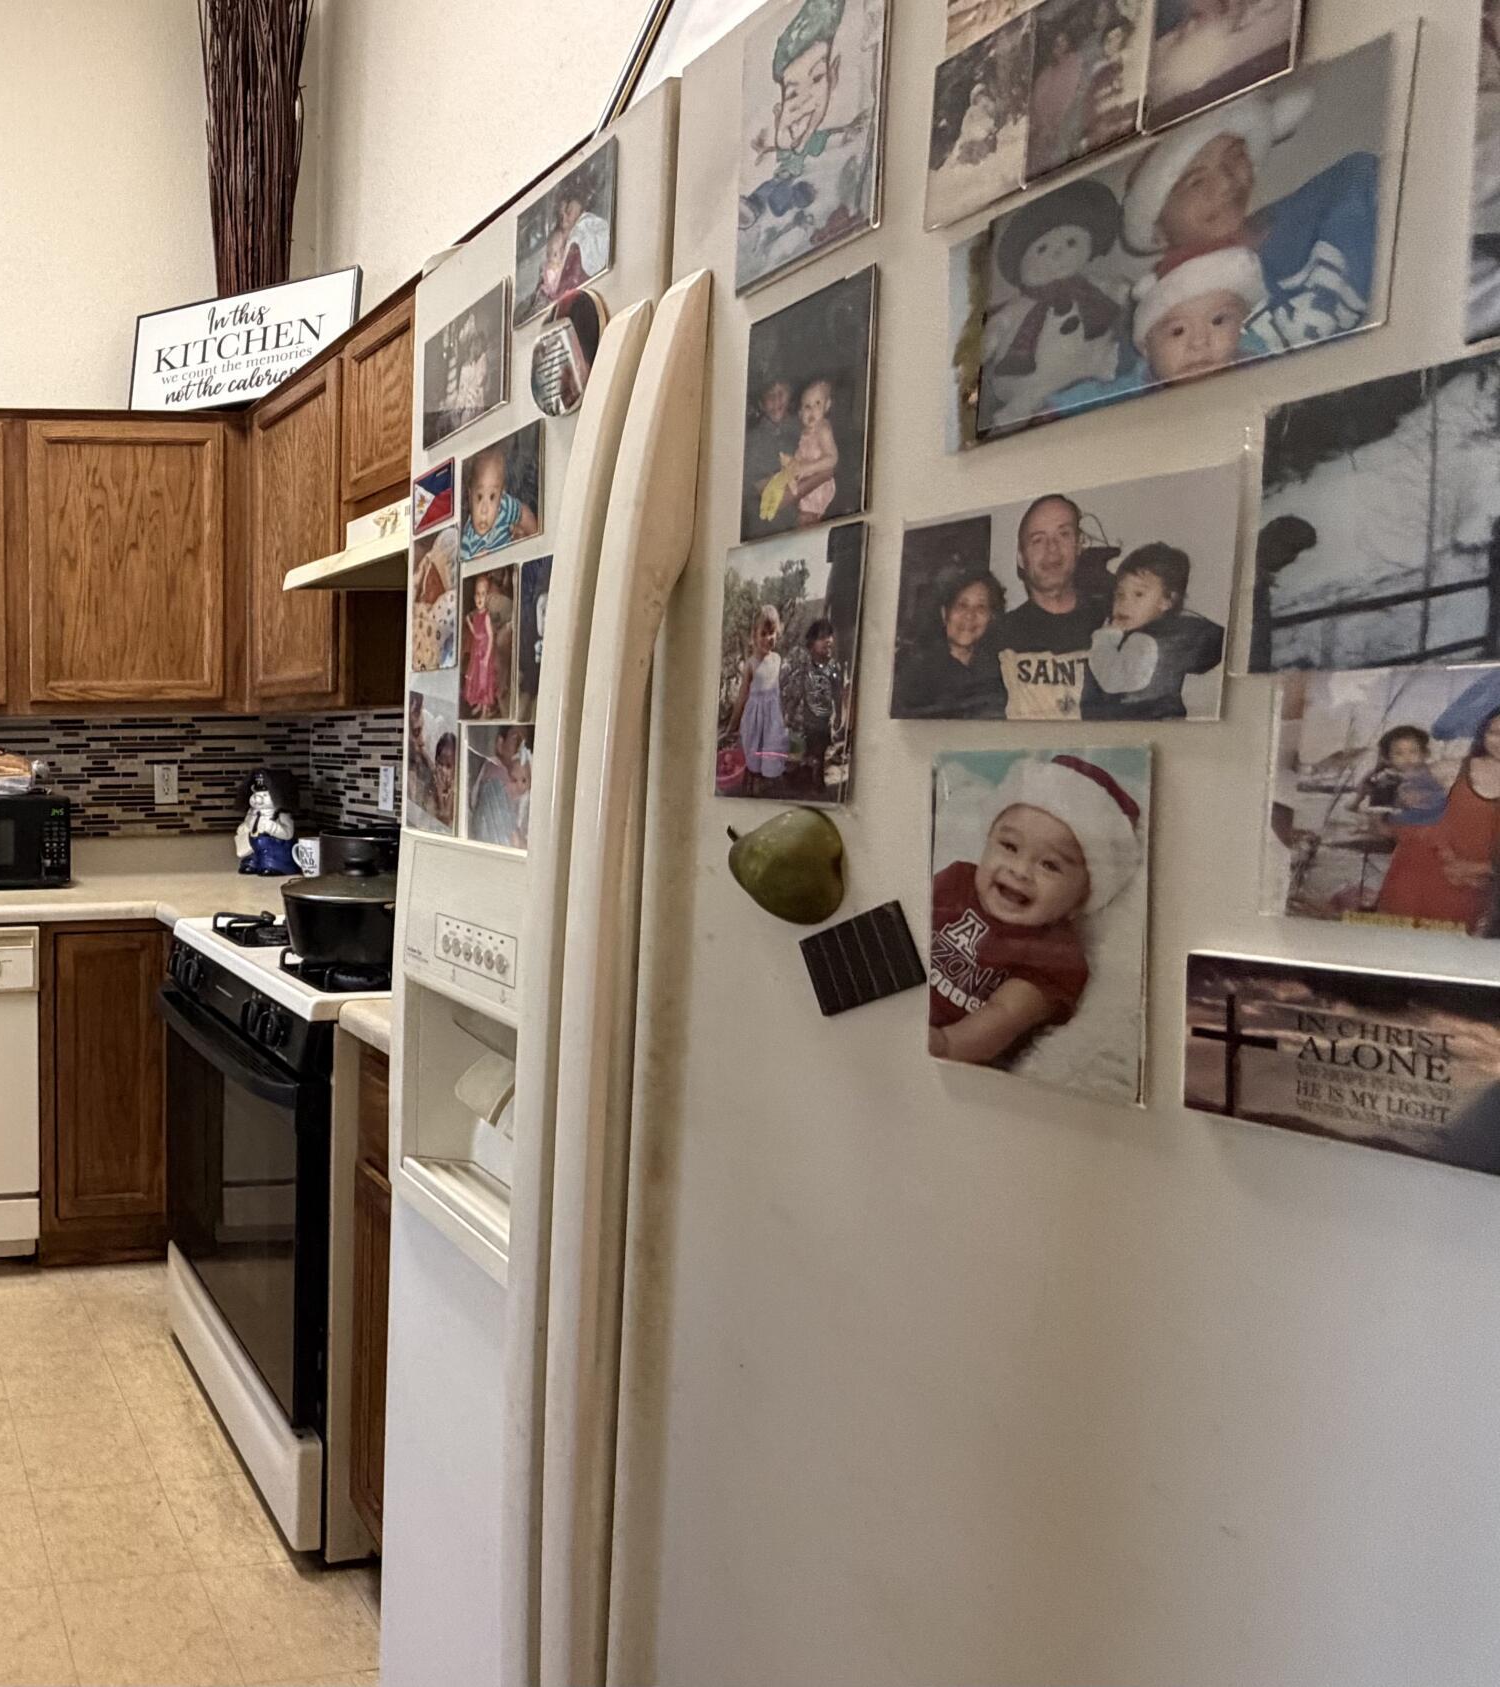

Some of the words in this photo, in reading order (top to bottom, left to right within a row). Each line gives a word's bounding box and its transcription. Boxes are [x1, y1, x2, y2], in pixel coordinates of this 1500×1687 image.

[207, 306, 231, 335] In
[229, 302, 271, 327] this
[152, 312, 329, 375] KITCHEN
[161, 372, 179, 385] we
[182, 366, 219, 382] count
[221, 359, 243, 374] the
[245, 346, 313, 369] memories
[164, 381, 198, 406] not
[196, 374, 227, 398] the
[1297, 1011, 1327, 1032] IN
[1337, 1018, 1455, 1055] CHRIST
[1297, 1036, 1452, 1084] ALONE
[1387, 1096, 1451, 1124] LIGHT
